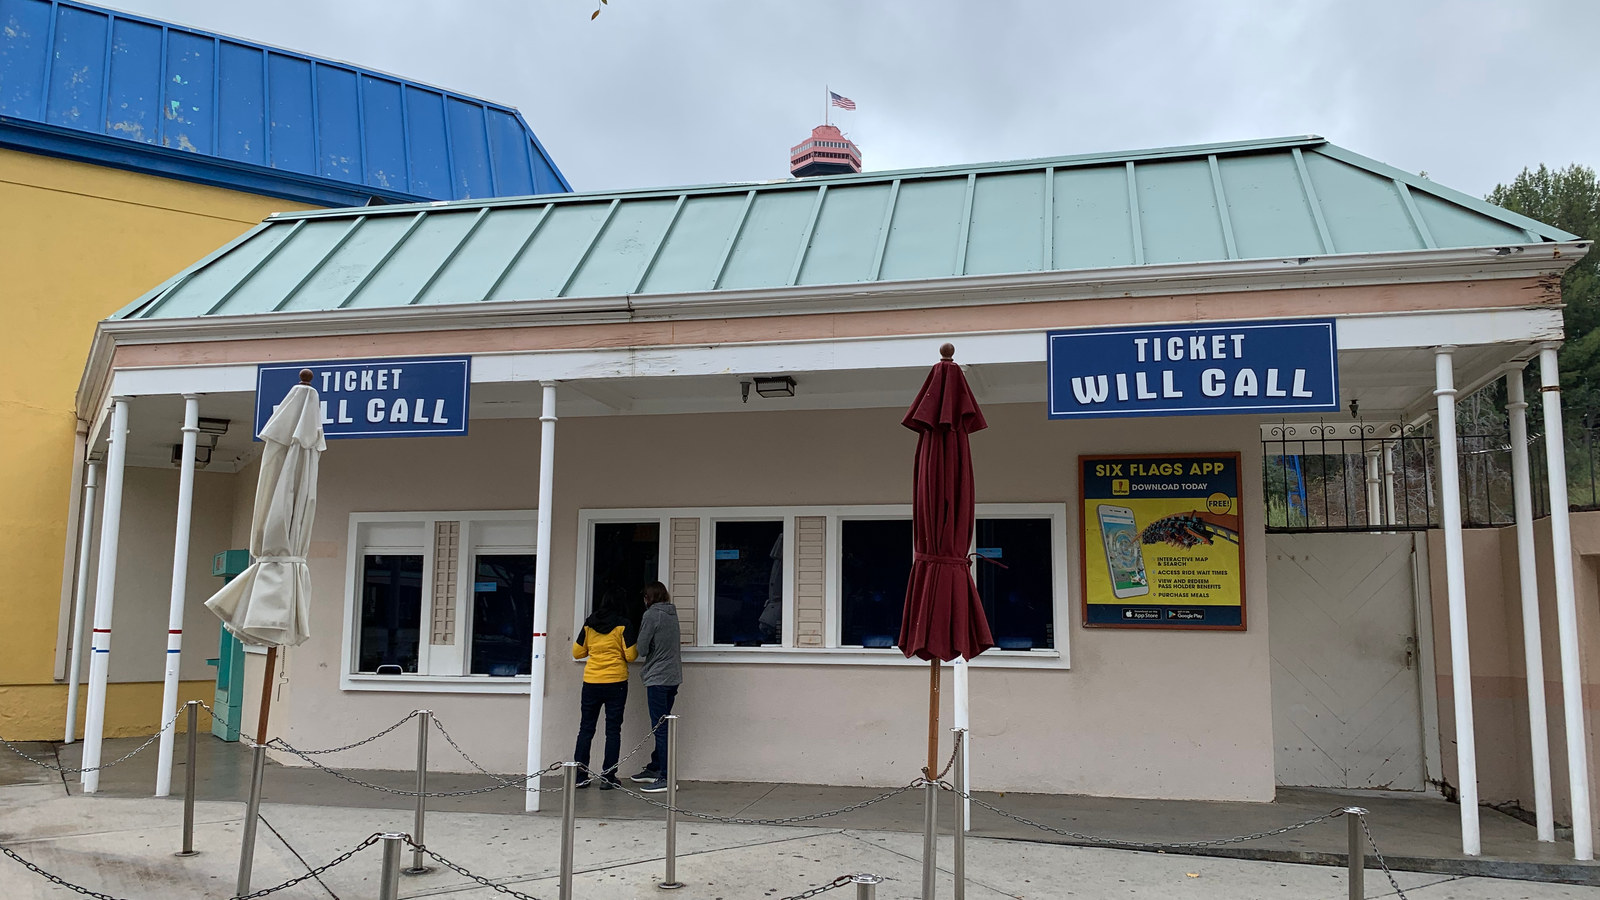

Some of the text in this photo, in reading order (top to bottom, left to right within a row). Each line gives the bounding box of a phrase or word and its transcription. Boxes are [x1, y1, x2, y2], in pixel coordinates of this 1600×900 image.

[1134, 334, 1245, 362] TICKET
[321, 368, 403, 393] TICKET
[1071, 368, 1313, 405] WILL CALL
[366, 397, 449, 425] CALL
[1095, 462, 1225, 477] SIX FLAGS APP
[1131, 483, 1179, 491] DOWNLOAD
